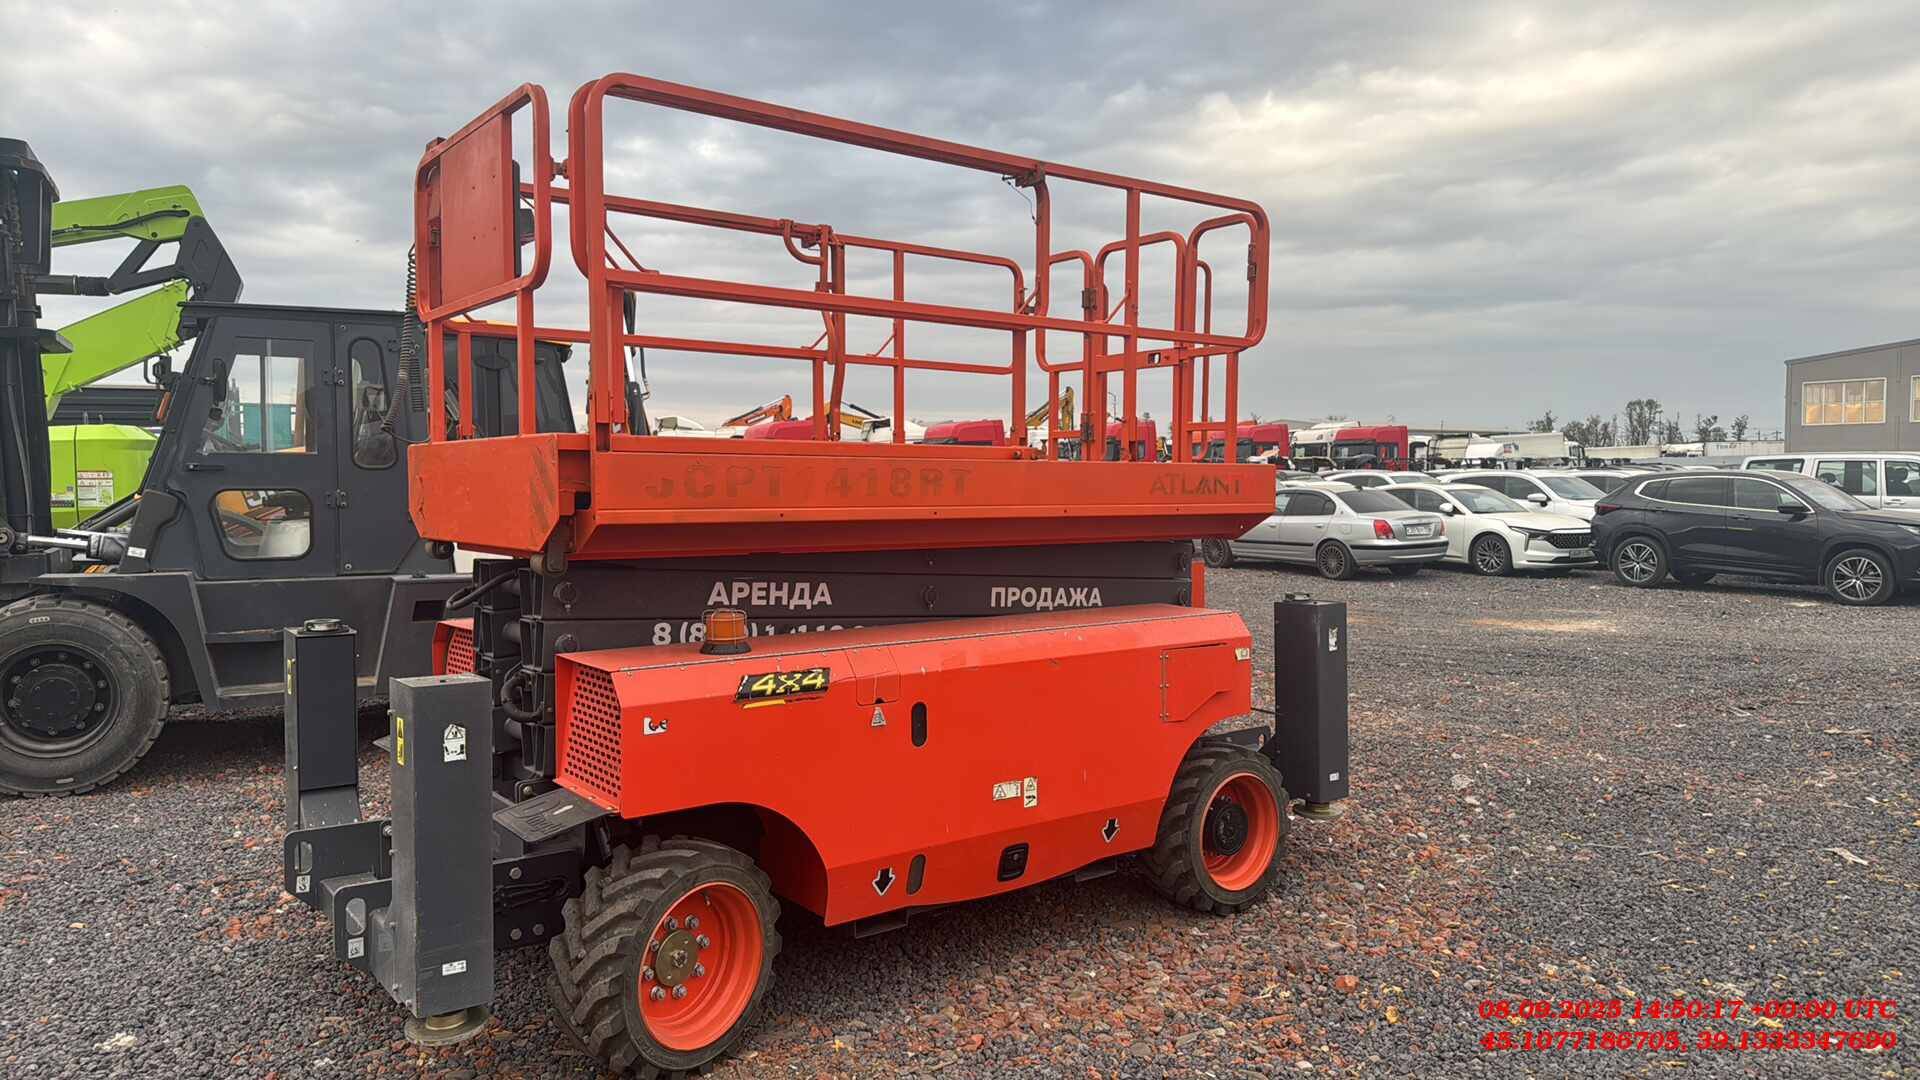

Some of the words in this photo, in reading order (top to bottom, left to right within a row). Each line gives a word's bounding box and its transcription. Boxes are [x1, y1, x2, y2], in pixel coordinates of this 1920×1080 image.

[642, 464, 973, 498] JCPT418RT
[1151, 472, 1245, 495] ATLANT
[708, 581, 833, 610] АРЕНДА
[990, 586, 1103, 611] ПРОДАЖА
[652, 622, 672, 646] 8
